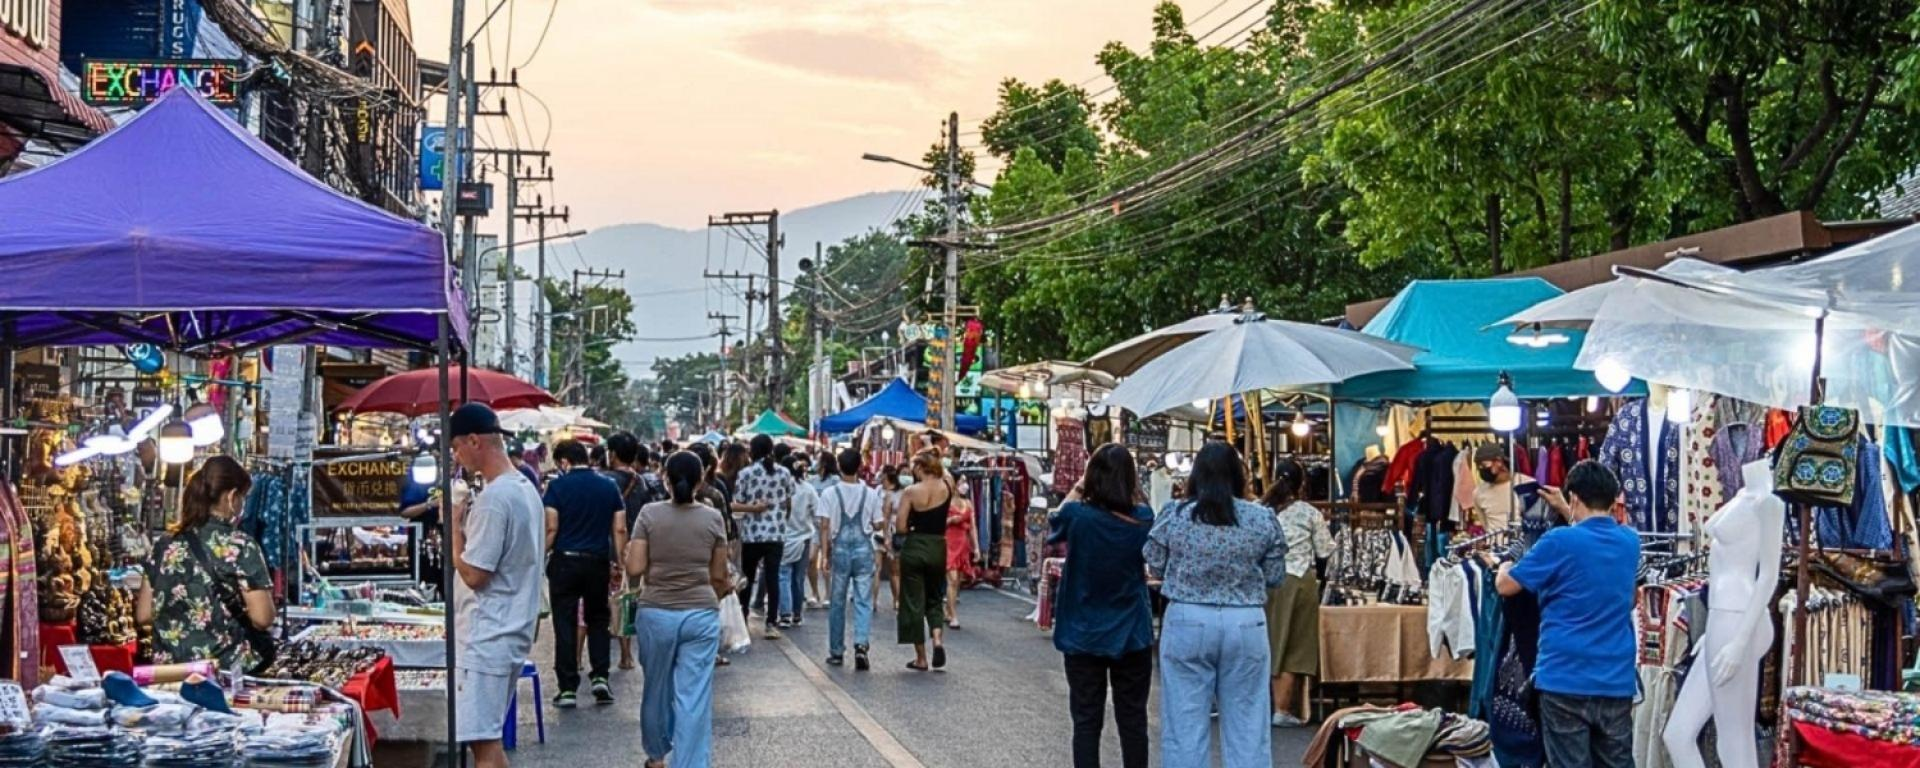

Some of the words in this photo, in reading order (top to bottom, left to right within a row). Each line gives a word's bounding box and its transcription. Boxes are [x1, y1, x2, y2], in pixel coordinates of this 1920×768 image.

[171, 0, 184, 58] RUGS
[91, 64, 230, 99] EXCHANGE
[327, 460, 410, 476] EXCHANGE
